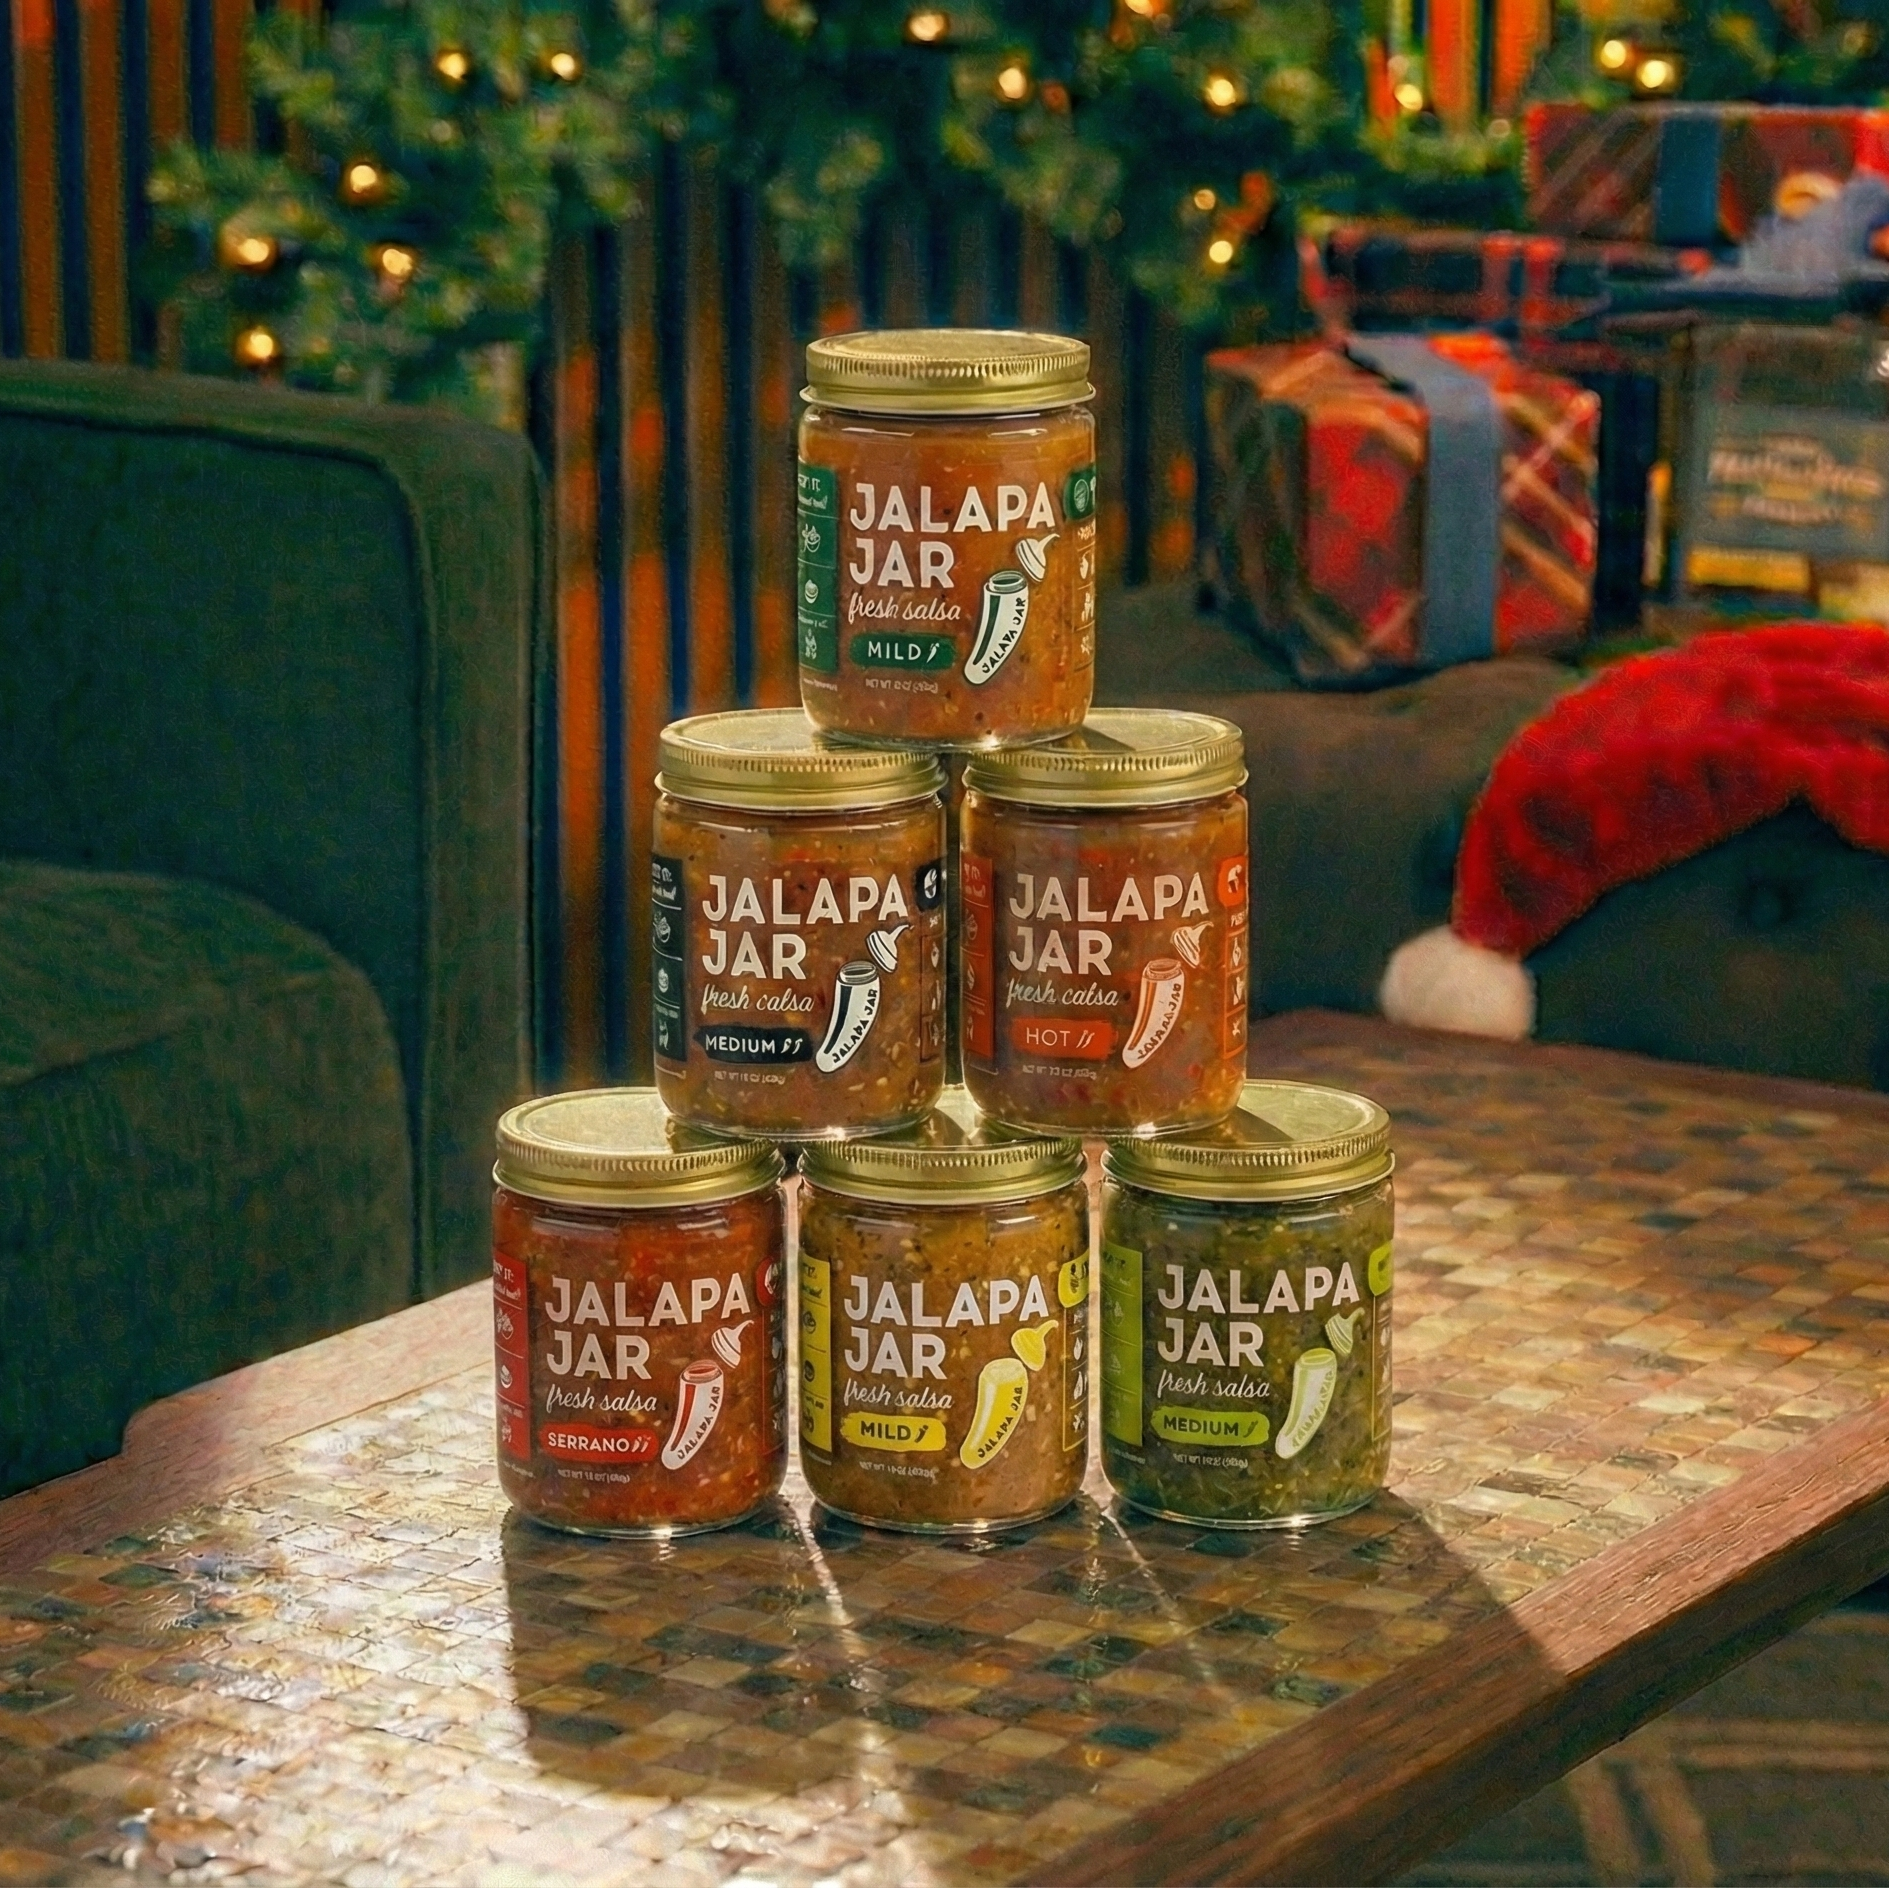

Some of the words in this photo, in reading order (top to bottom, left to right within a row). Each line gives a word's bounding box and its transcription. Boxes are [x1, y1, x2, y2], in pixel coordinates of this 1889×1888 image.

[850, 481, 1056, 533] JALAPA
[849, 537, 955, 588] JAR
[848, 592, 900, 625] fresh
[902, 597, 961, 621] salsa
[868, 641, 922, 661] MILD
[702, 873, 909, 925] JALAPA
[1009, 872, 1210, 923] JALAPA
[701, 928, 807, 980] JAR
[1008, 926, 1112, 976] JAR
[700, 983, 750, 1015] fresh
[705, 1035, 776, 1054] MEDIUM
[1026, 1027, 1070, 1047] HOT
[545, 1272, 751, 1327] JALAPA
[844, 1274, 1049, 1328] JALAPA
[1157, 1261, 1360, 1314] JALAPA
[546, 1329, 652, 1380] JAR
[844, 1326, 948, 1380] JAR
[1157, 1317, 1264, 1368] JAR
[546, 1383, 596, 1414] fresh
[600, 1389, 657, 1412] salsa
[843, 1377, 891, 1407] fresh
[894, 1386, 954, 1409] salsa
[1157, 1369, 1209, 1399] fresh
[1212, 1373, 1270, 1398] salsa
[548, 1432, 630, 1453] SERRANO
[860, 1420, 911, 1441] MILD
[1163, 1415, 1239, 1436] MEDIUM
